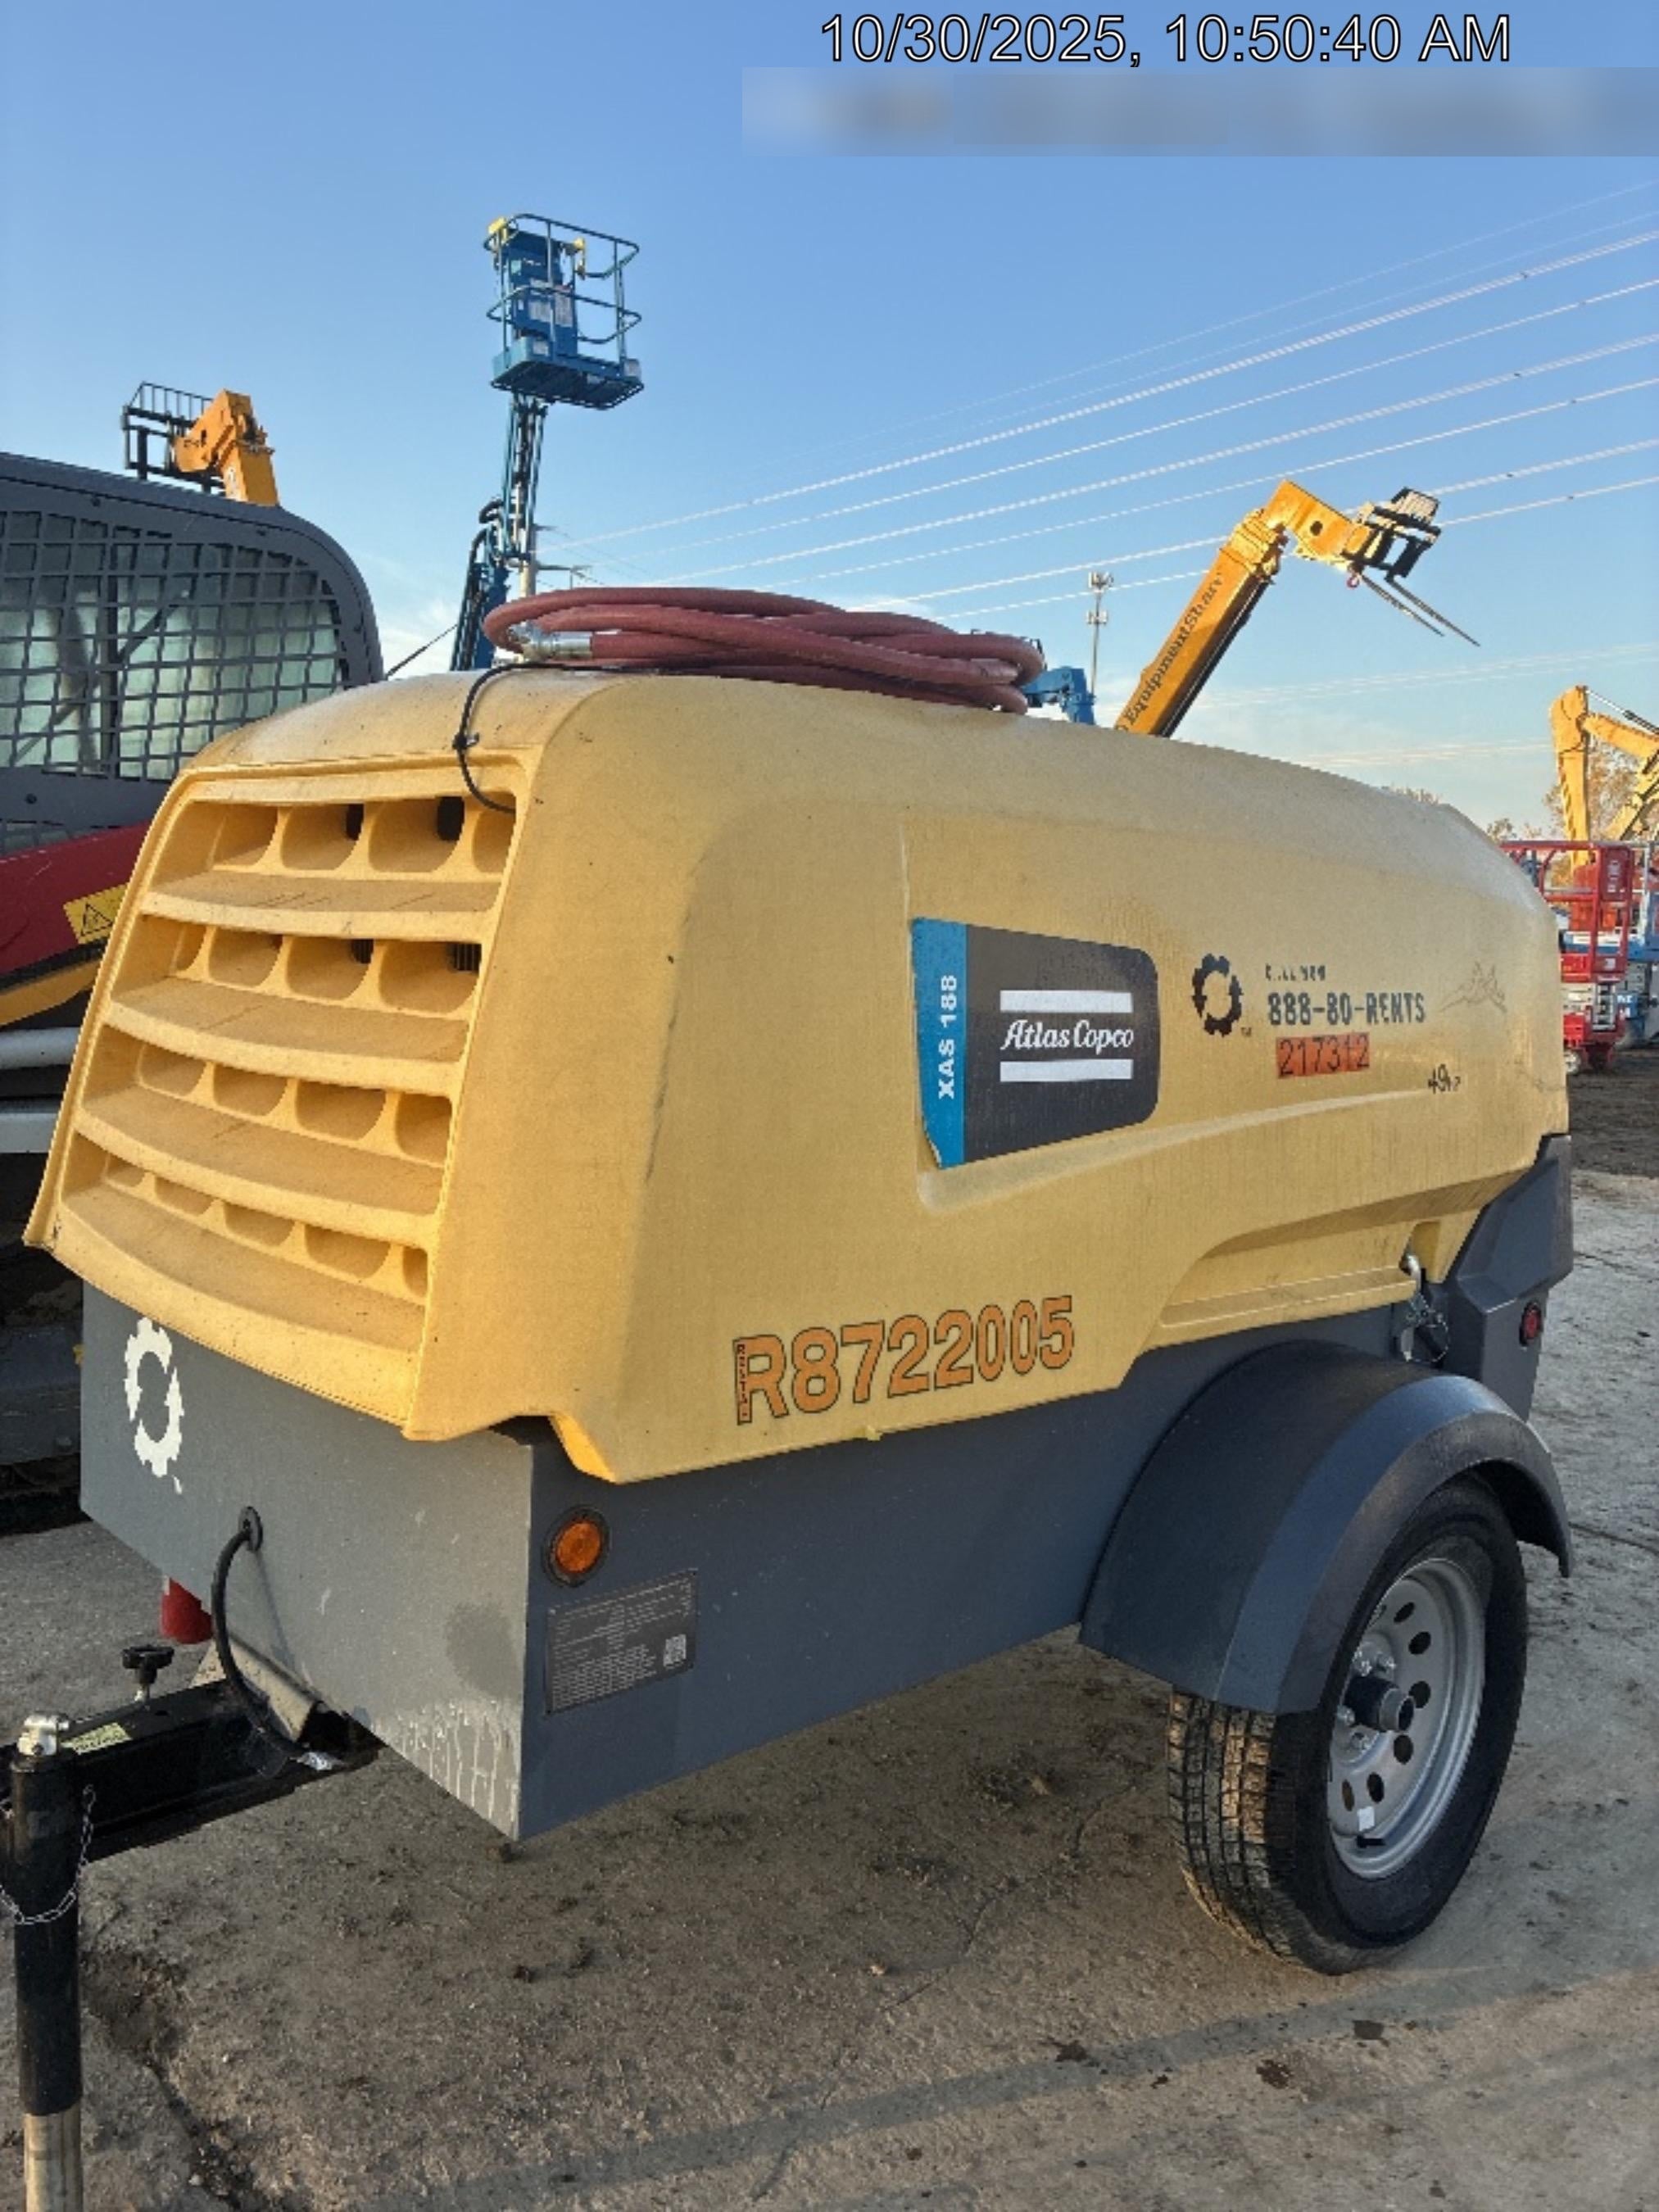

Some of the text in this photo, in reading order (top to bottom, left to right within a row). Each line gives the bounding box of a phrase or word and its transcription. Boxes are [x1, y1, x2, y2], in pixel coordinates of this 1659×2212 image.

[1123, 571, 1223, 726] EquipmentShar
[938, 975, 957, 1099] XAS 188
[999, 1019, 1134, 1055] Atlas Copco
[1267, 991, 1426, 1026] 888-80-RENTS
[1279, 1033, 1371, 1077] 217312
[733, 1295, 1074, 1425] R8722005
